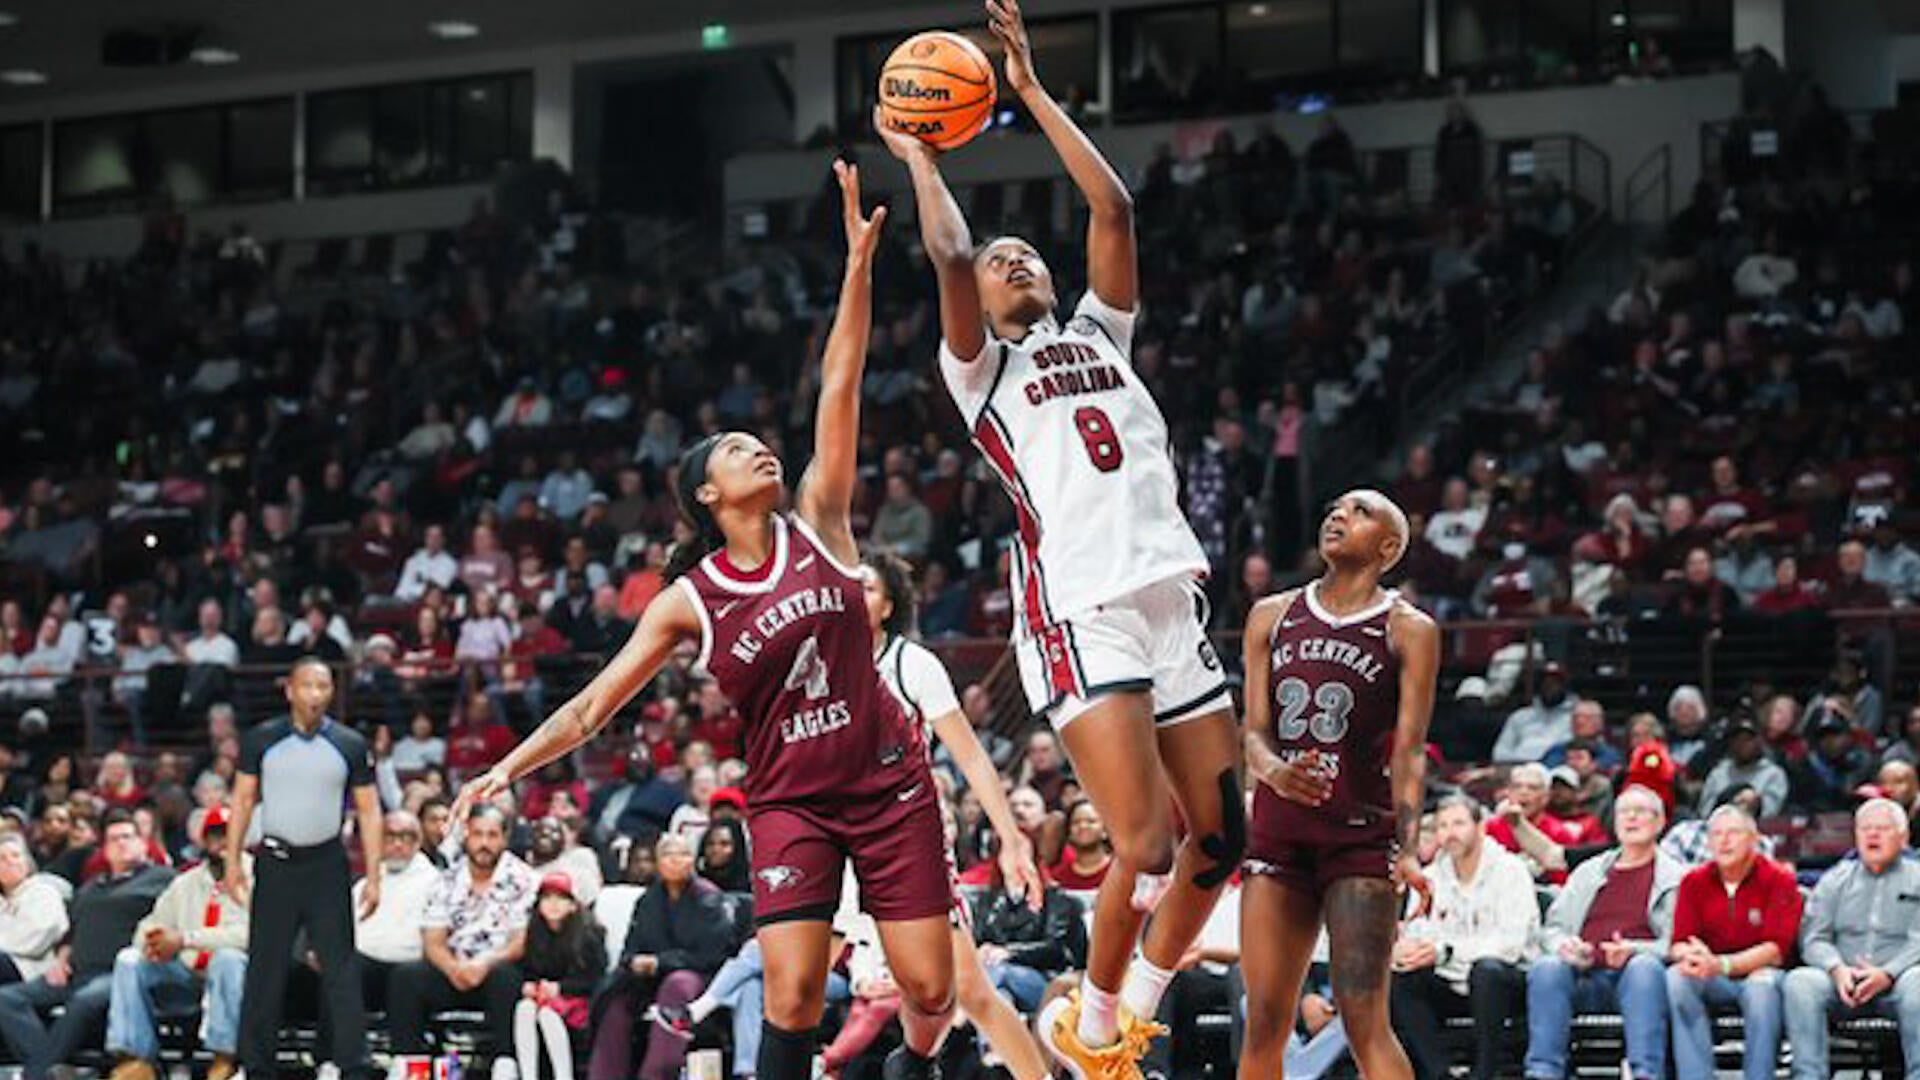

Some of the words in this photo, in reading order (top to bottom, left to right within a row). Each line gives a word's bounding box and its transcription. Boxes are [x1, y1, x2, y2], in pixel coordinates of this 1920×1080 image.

[885, 77, 951, 101] Wilson
[1031, 342, 1101, 370] SOUTH
[1024, 365, 1126, 406] CAROLINA
[1074, 405, 1124, 473] 8
[88, 617, 116, 655] 3
[730, 629, 763, 664] NC
[754, 587, 845, 639] CENTRAL
[784, 634, 830, 701] 4
[1271, 646, 1294, 671] NC
[1299, 639, 1383, 683] CENTRAL
[780, 699, 851, 743] EAGLES
[1275, 676, 1355, 744] 23
